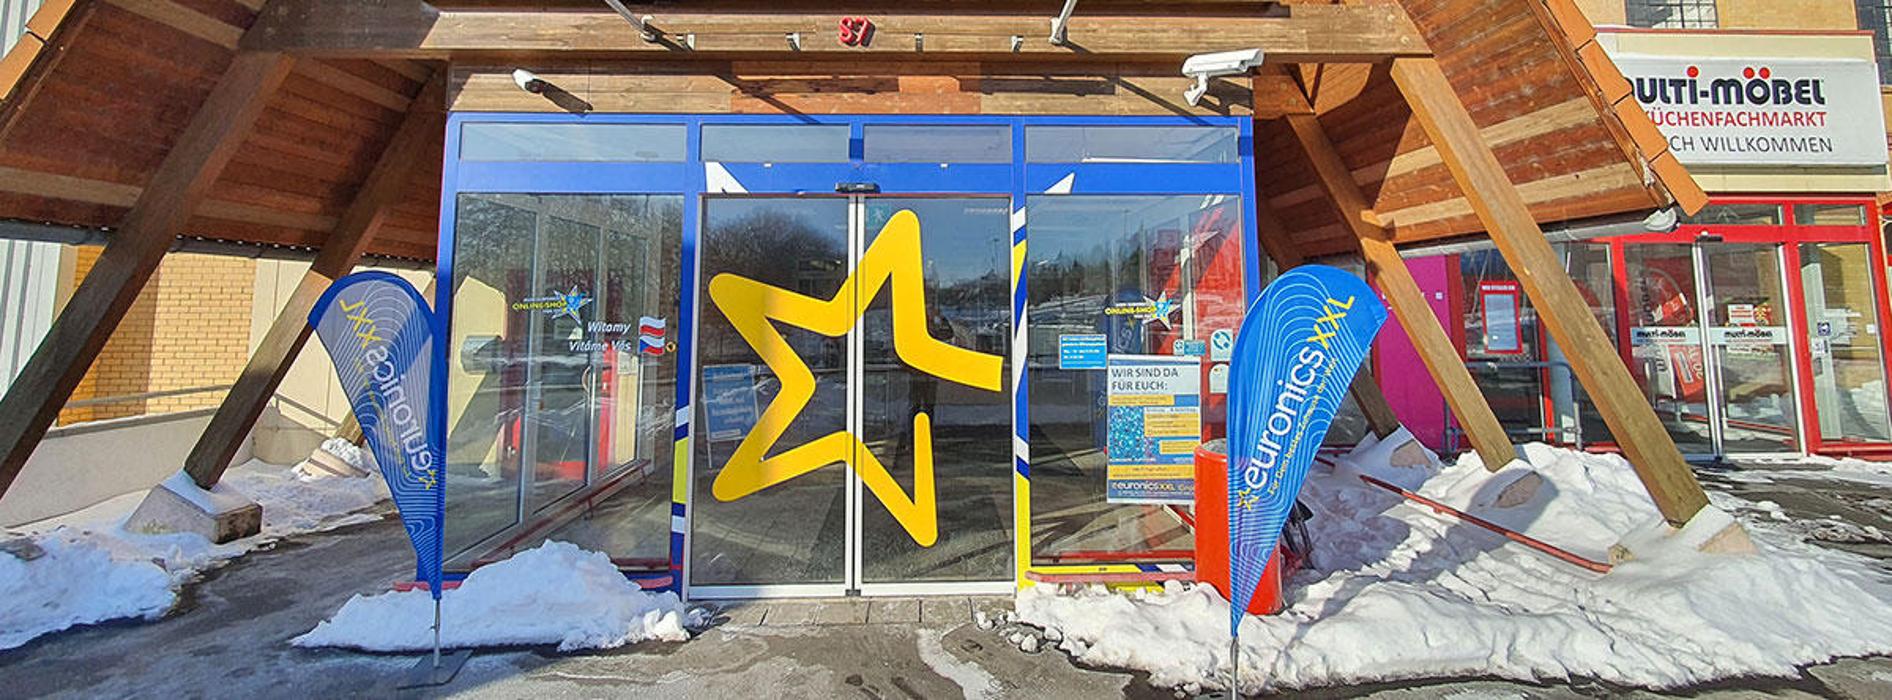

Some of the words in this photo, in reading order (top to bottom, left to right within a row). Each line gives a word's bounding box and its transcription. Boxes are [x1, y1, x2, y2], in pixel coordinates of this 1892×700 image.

[1646, 107, 1827, 127] ÜCHENFACHMARKT
[1701, 136, 1833, 153] WILLKOMMEN
[588, 322, 631, 335] Witamy
[1111, 368, 1133, 378] WIR
[1135, 368, 1161, 378] SIND
[1163, 368, 1179, 377] DA
[1135, 380, 1168, 391] EUCH:
